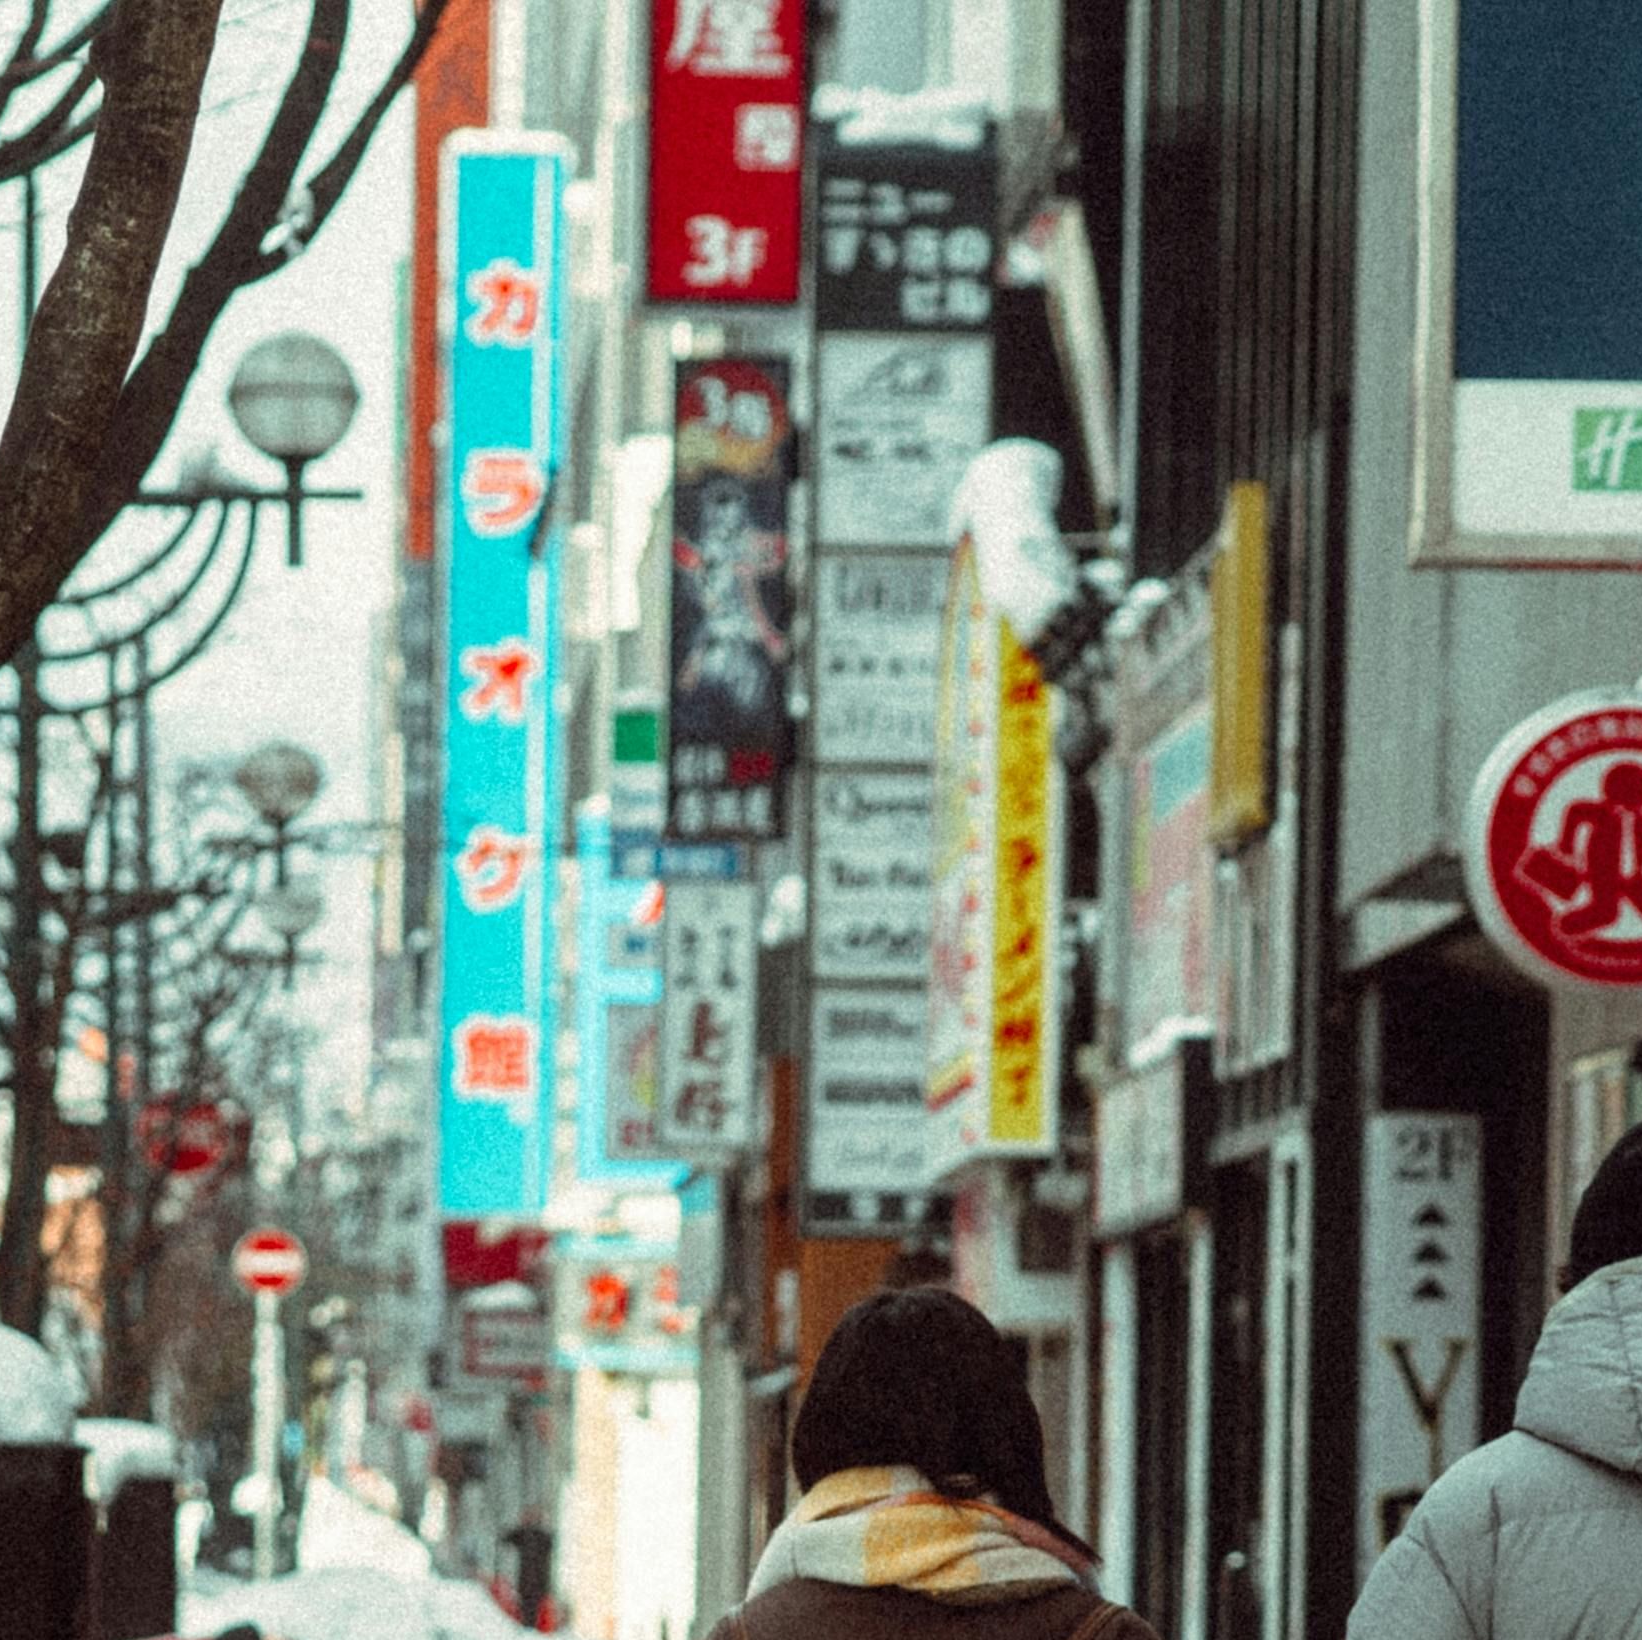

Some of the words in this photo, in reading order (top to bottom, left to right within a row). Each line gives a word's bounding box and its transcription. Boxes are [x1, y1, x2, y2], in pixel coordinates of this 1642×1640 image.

[682, 213, 768, 288] 3F
[455, 256, 543, 1100] カラオケ館
